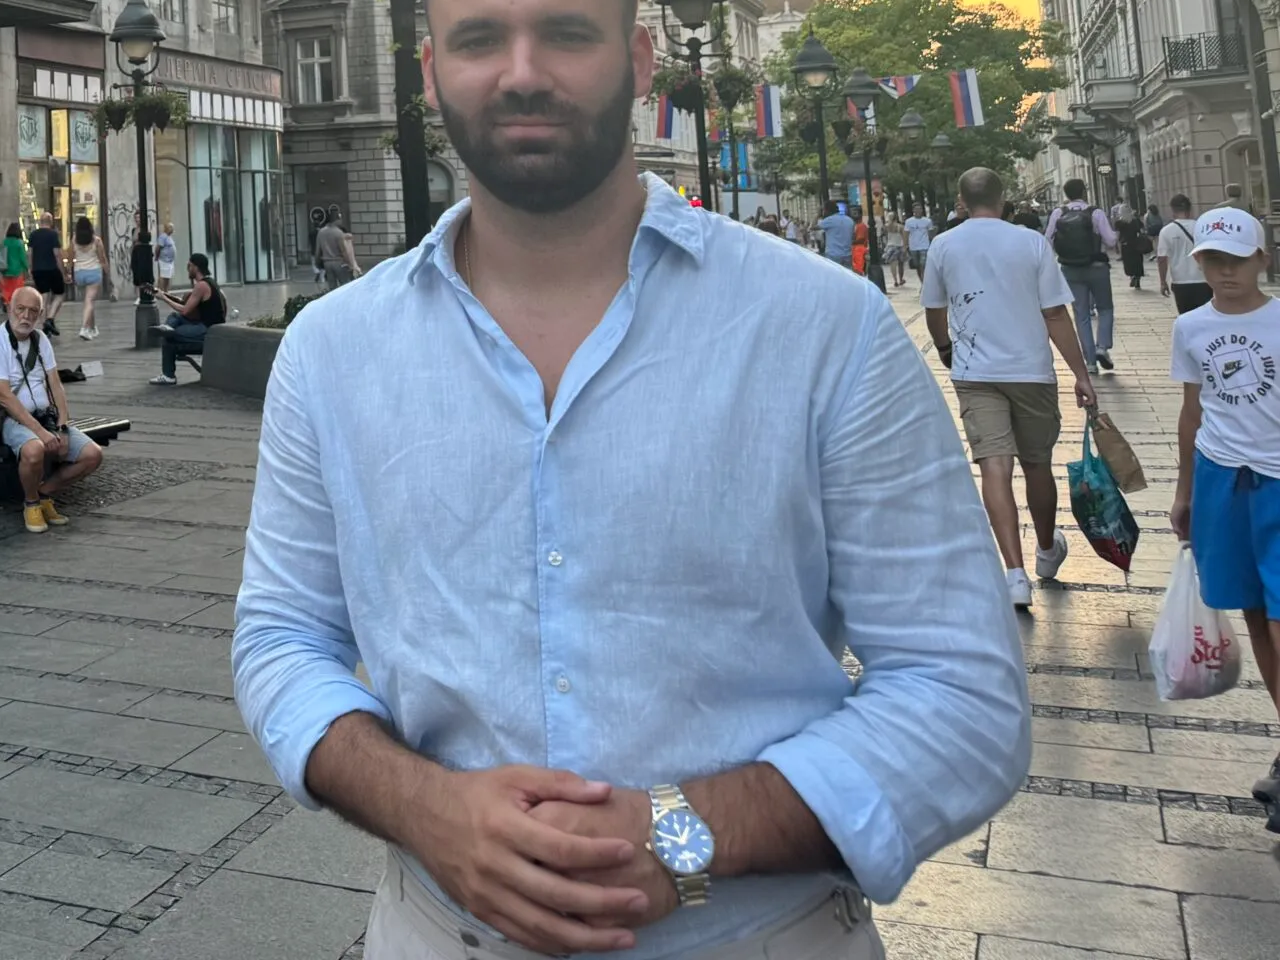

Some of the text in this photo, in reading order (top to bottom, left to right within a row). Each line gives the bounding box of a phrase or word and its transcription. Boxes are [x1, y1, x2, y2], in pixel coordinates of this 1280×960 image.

[1205, 336, 1227, 355] JUST
[1230, 334, 1247, 345] DO
[1249, 341, 1263, 354] IT.
[1261, 356, 1276, 380] JUST
[1256, 381, 1272, 396] DO
[1216, 389, 1239, 405] JUST
